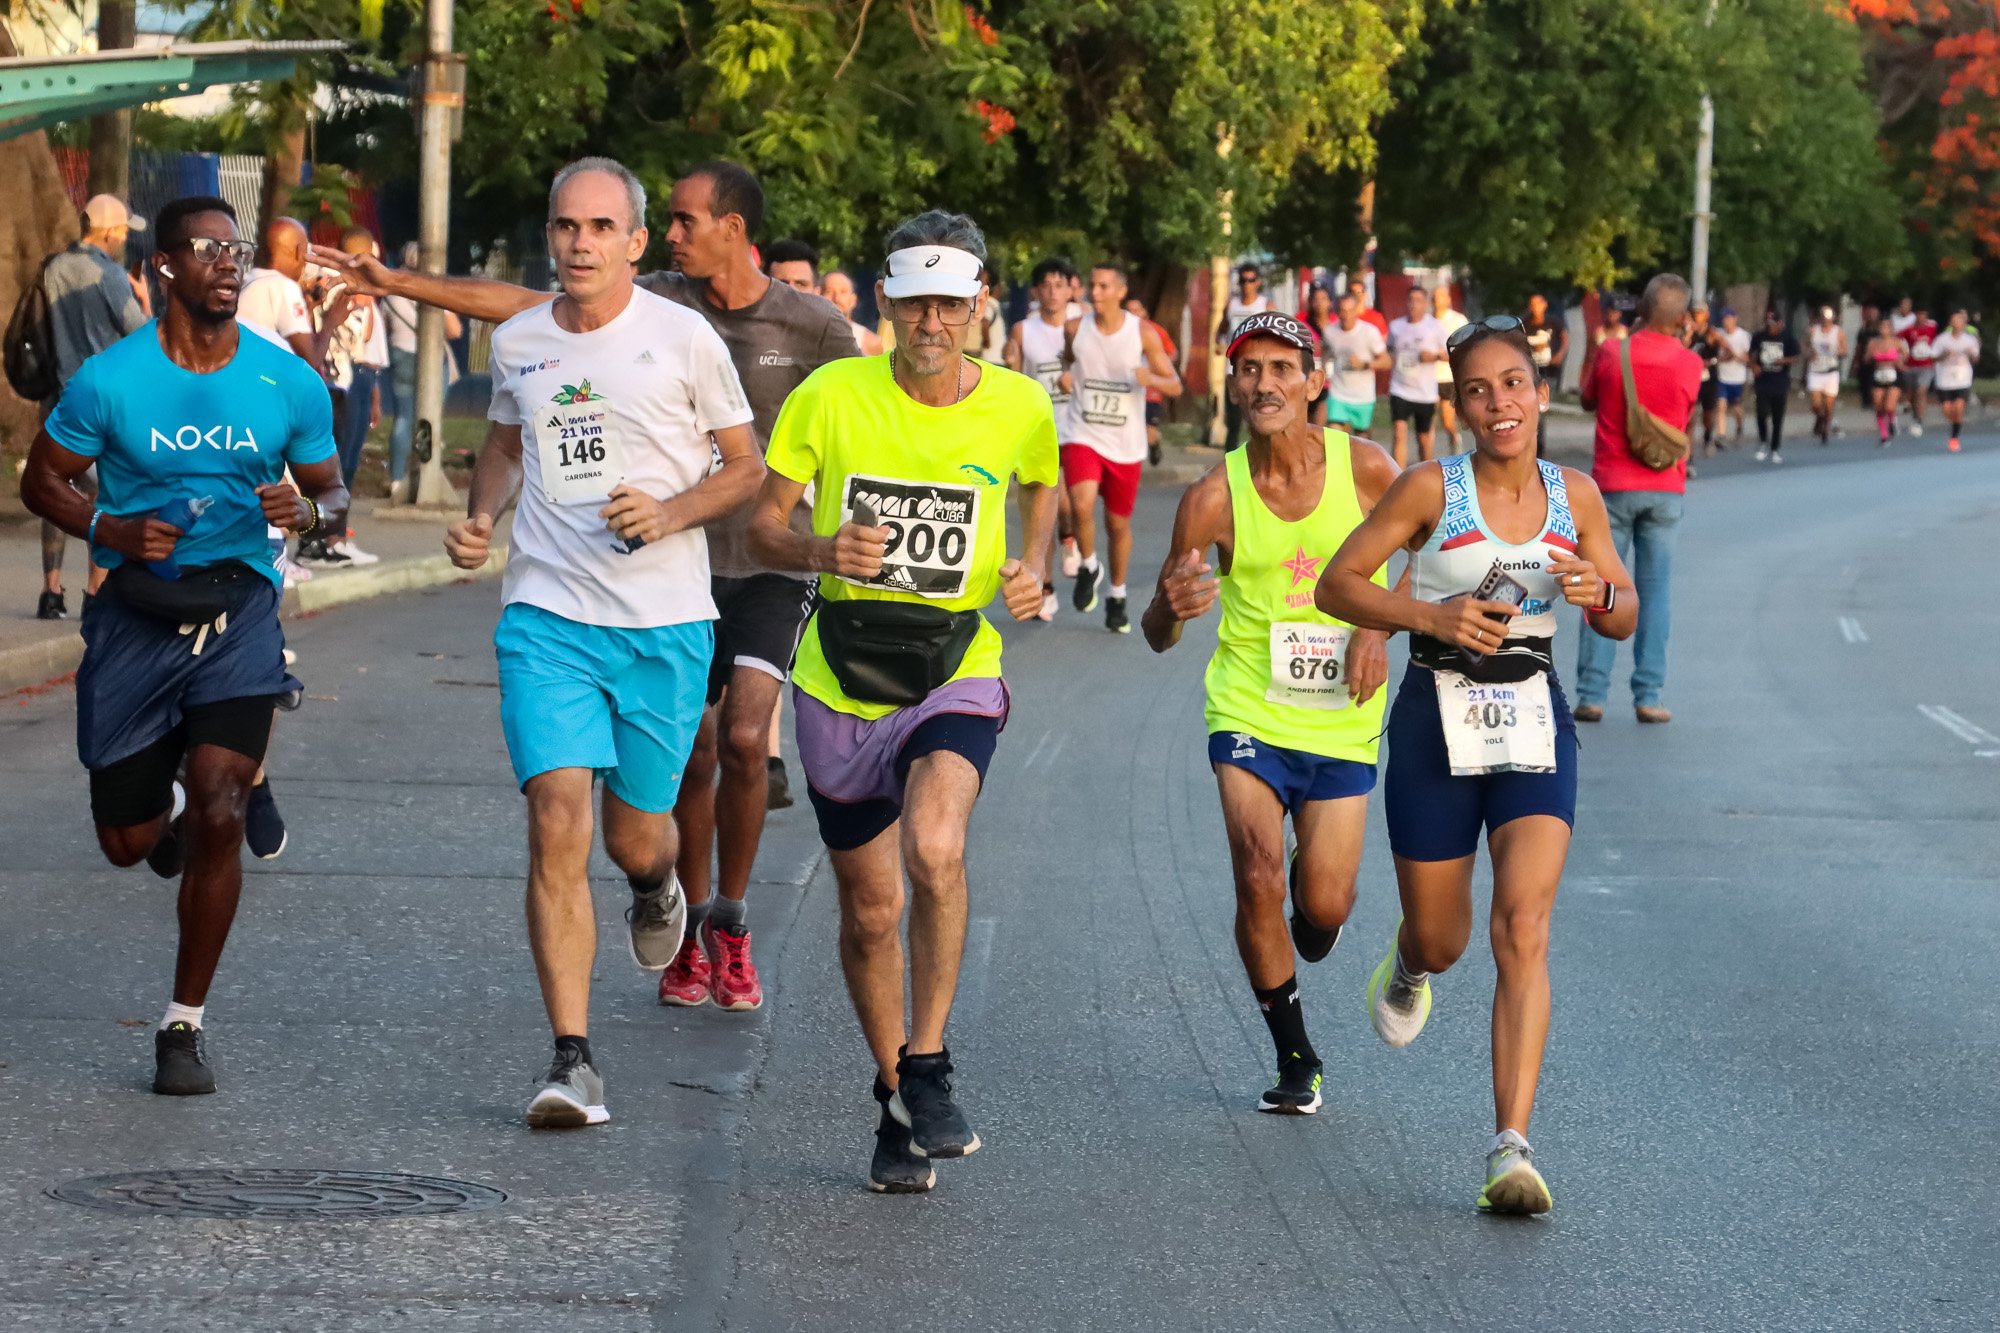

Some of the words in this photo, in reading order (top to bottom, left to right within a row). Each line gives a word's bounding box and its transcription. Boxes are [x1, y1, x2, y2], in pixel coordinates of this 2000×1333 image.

[1235, 315, 1299, 338] MÉXICO
[758, 355, 778, 366] UCI
[1092, 394, 1121, 413] 173
[150, 425, 259, 452] NOKIA
[560, 427, 578, 439] 21
[582, 425, 602, 436] km
[558, 437, 606, 467] 146
[564, 470, 602, 482] CARDENAS
[934, 510, 966, 523] CUBA
[884, 577, 918, 591] adidas
[1290, 644, 1307, 656] 10
[1312, 645, 1333, 656] km
[1290, 656, 1339, 681] 676
[1286, 686, 1315, 694] ANDRES
[1468, 688, 1488, 702] 21
[1492, 688, 1515, 701] km
[1464, 702, 1518, 731] 403
[1484, 736, 1504, 745] YOLE
